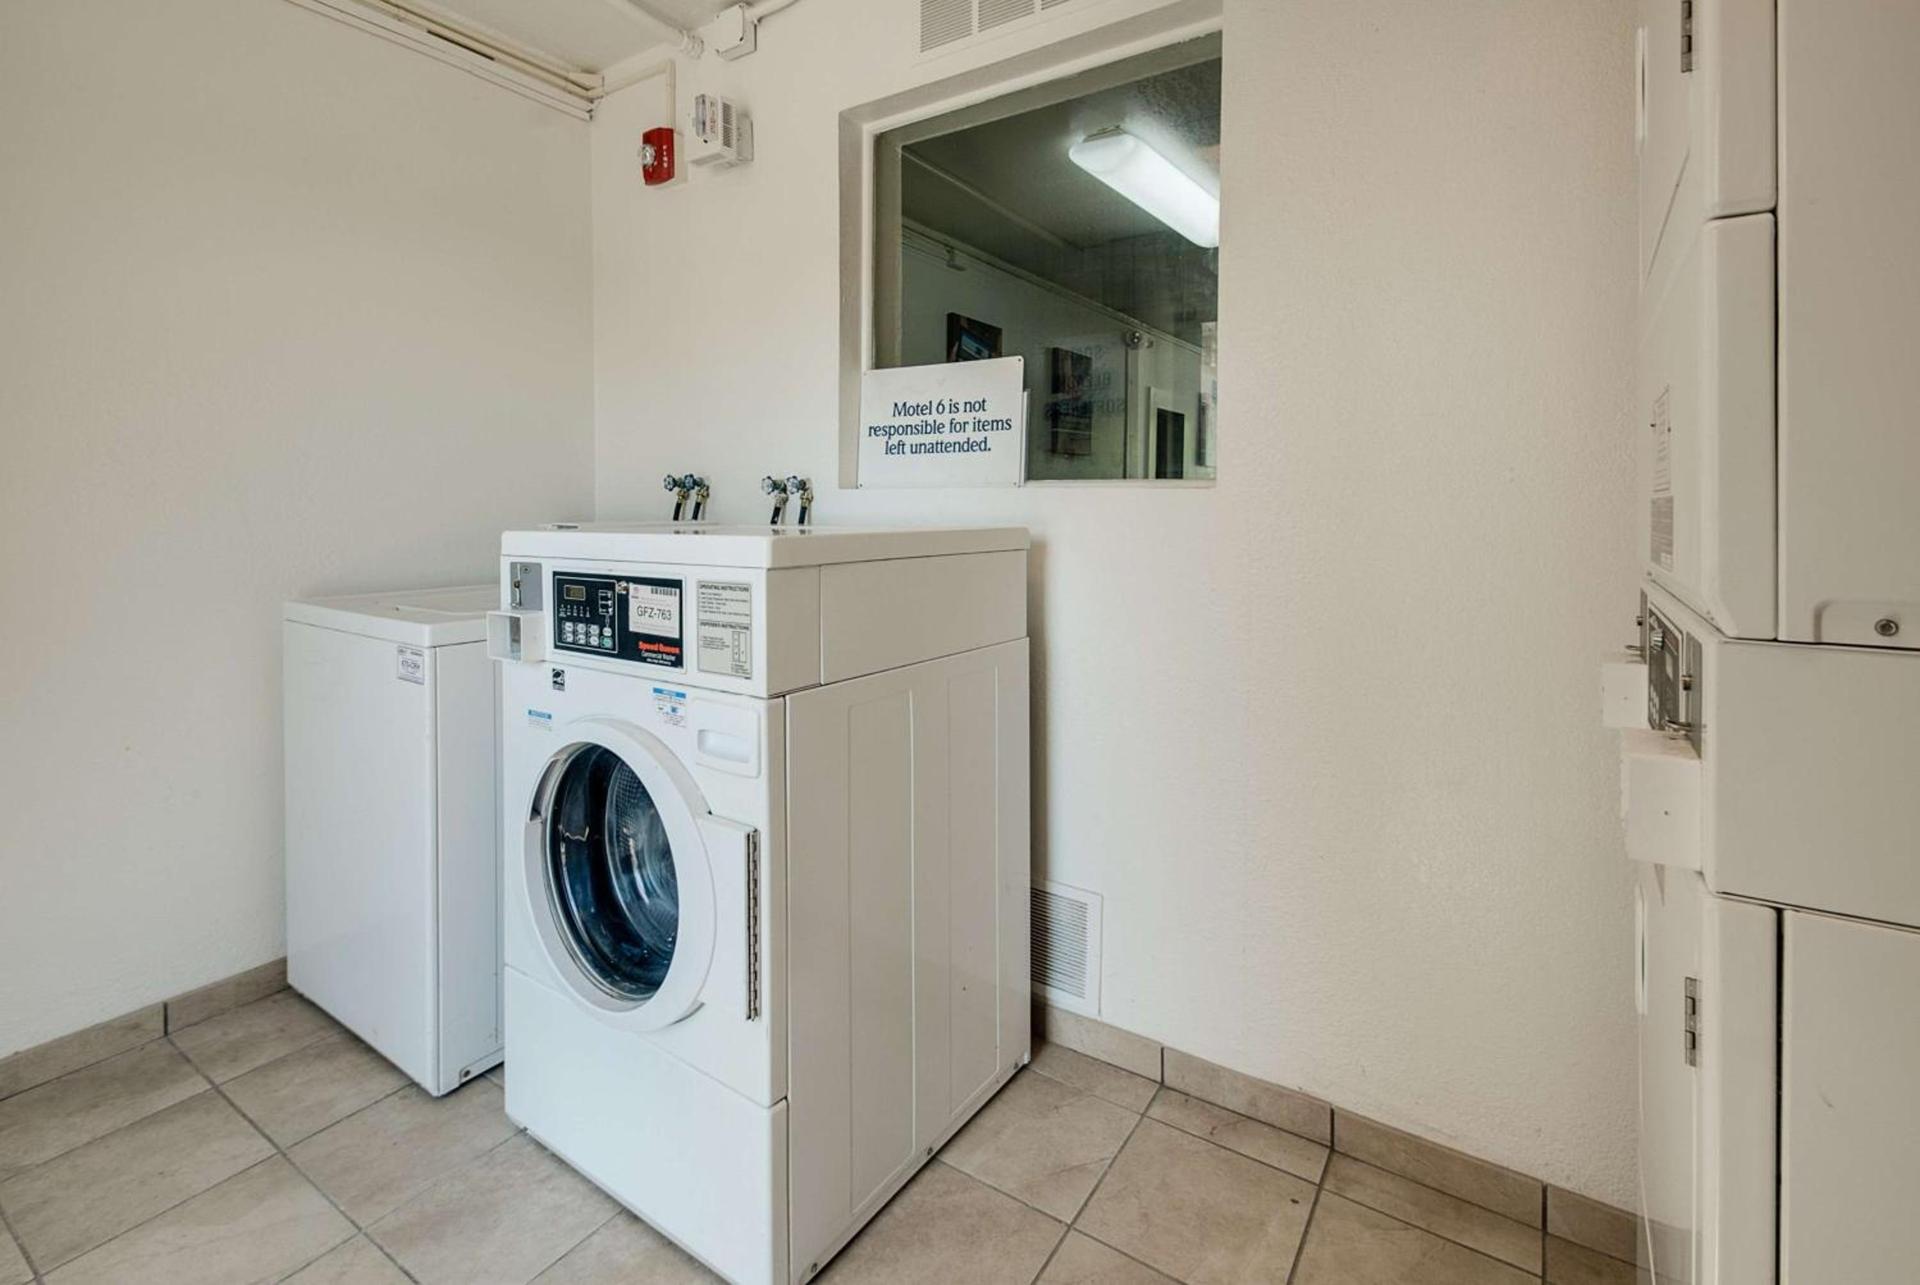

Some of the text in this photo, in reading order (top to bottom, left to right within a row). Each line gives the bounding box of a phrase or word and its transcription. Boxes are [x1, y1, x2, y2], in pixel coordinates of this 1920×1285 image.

[892, 398, 987, 417] Motel 6 is not
[868, 417, 1012, 440] responsible for items
[884, 437, 992, 455] left unattended.
[637, 605, 672, 620] GFZ-763
